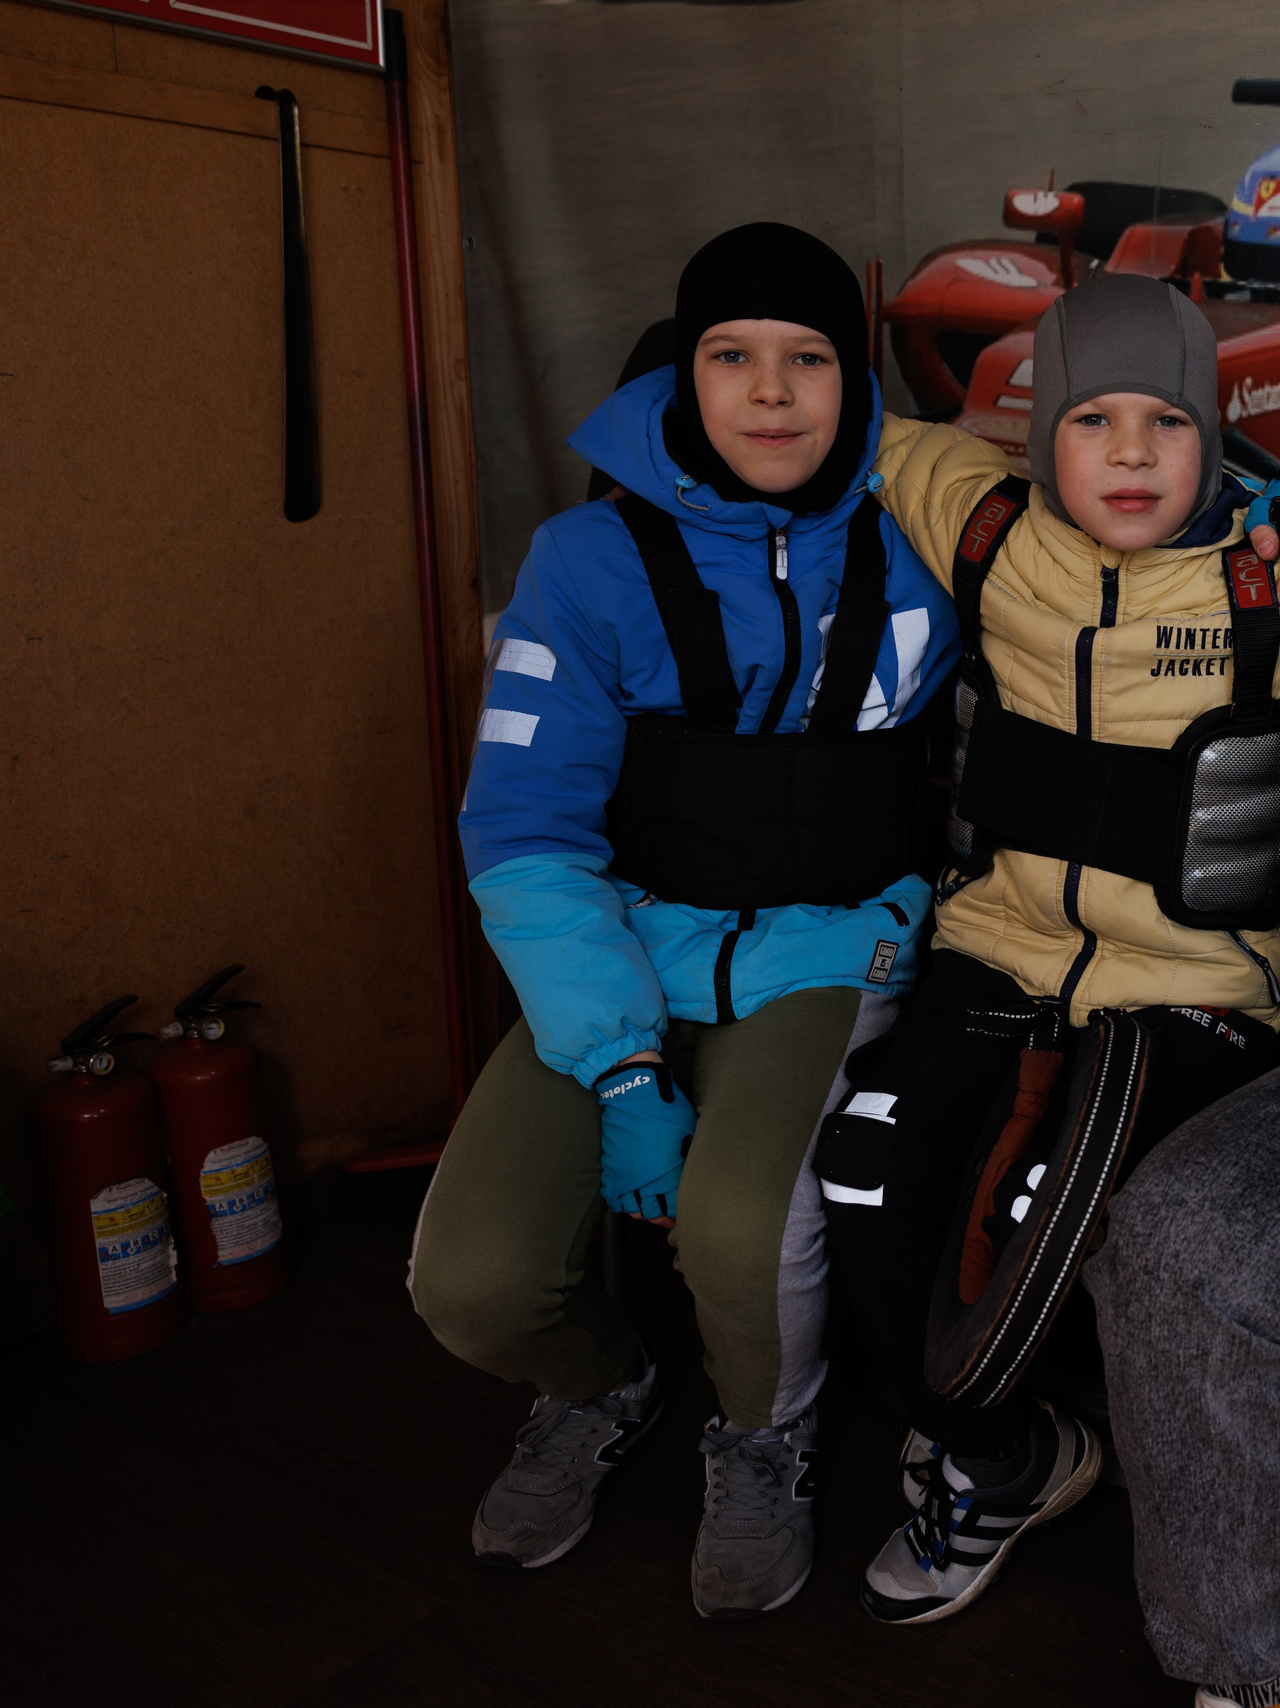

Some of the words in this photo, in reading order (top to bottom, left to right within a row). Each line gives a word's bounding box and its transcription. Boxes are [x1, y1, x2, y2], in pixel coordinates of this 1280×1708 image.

[1156, 625, 1234, 650] WINTER
[1150, 656, 1229, 677] JACKET
[1215, 1021, 1246, 1050] FIRE
